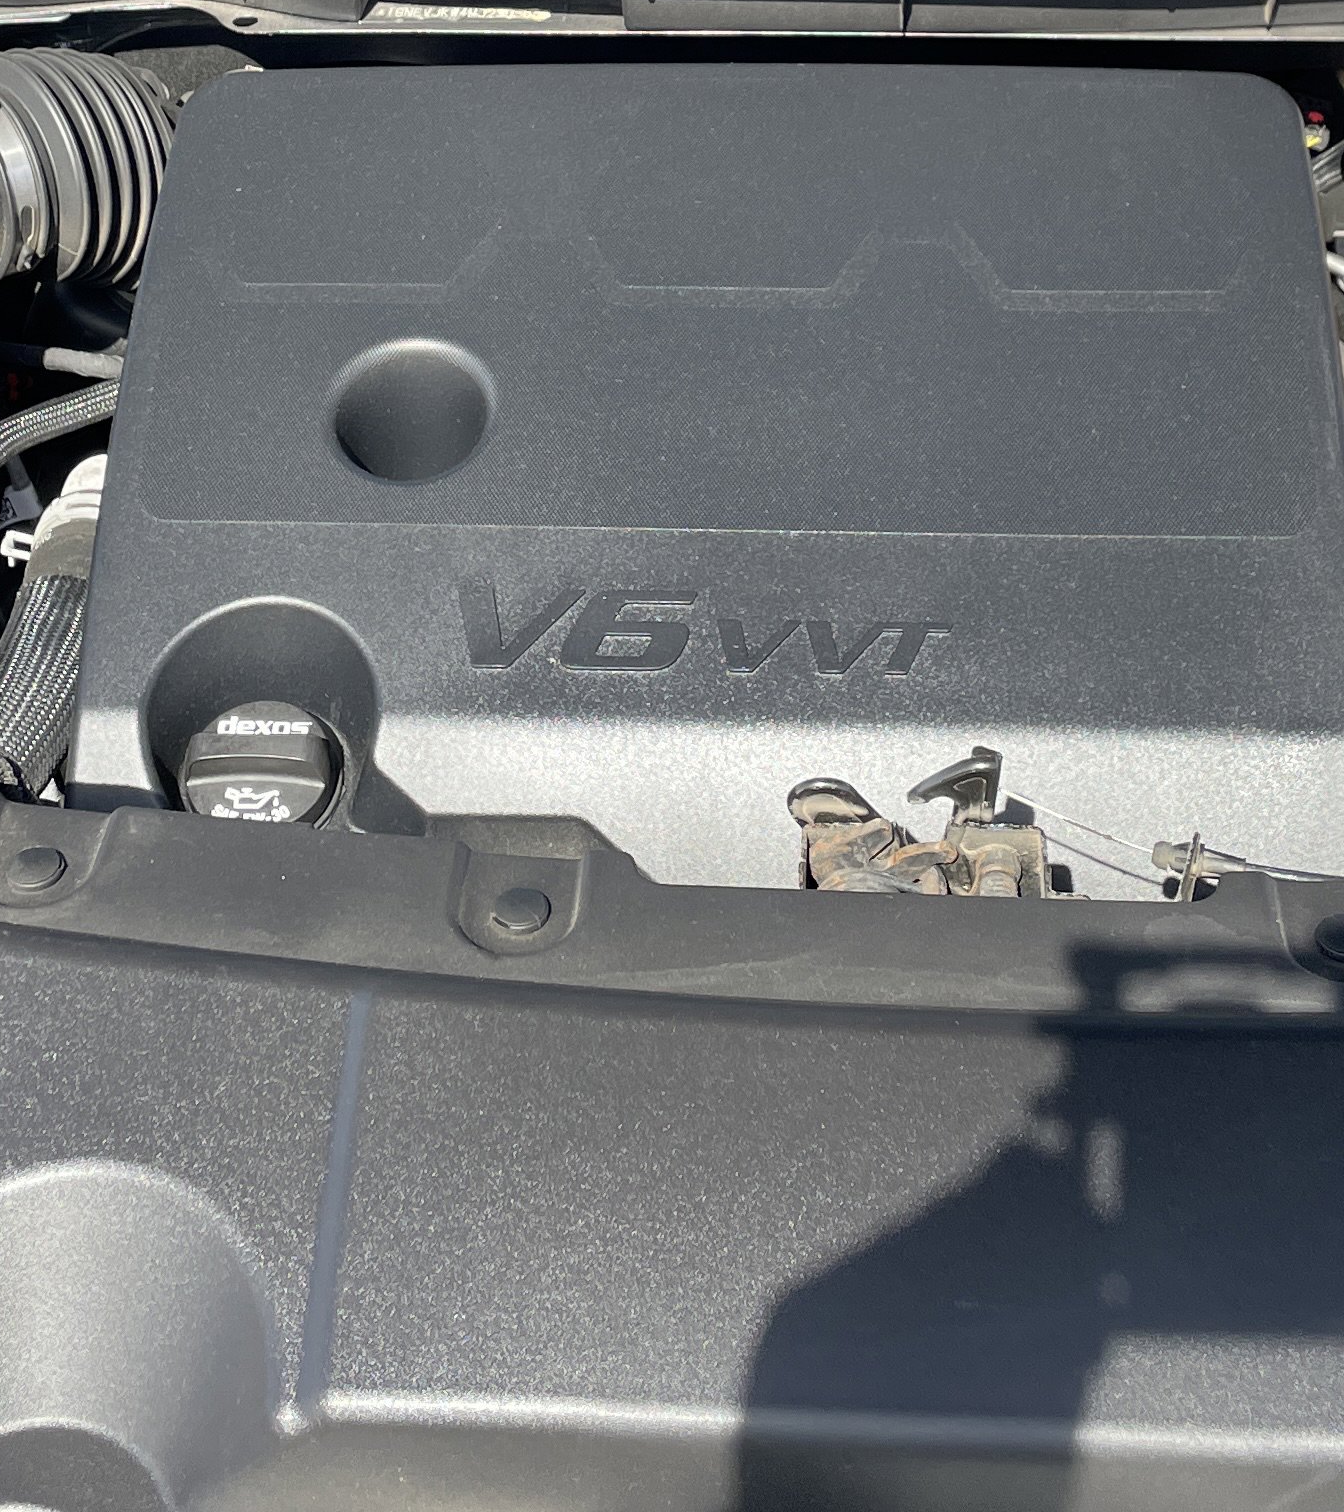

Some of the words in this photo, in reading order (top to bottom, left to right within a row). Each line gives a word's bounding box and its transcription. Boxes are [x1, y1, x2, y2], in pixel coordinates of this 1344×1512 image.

[458, 586, 698, 672] V6
[717, 618, 954, 677] VVT
[216, 716, 309, 735] dexos
